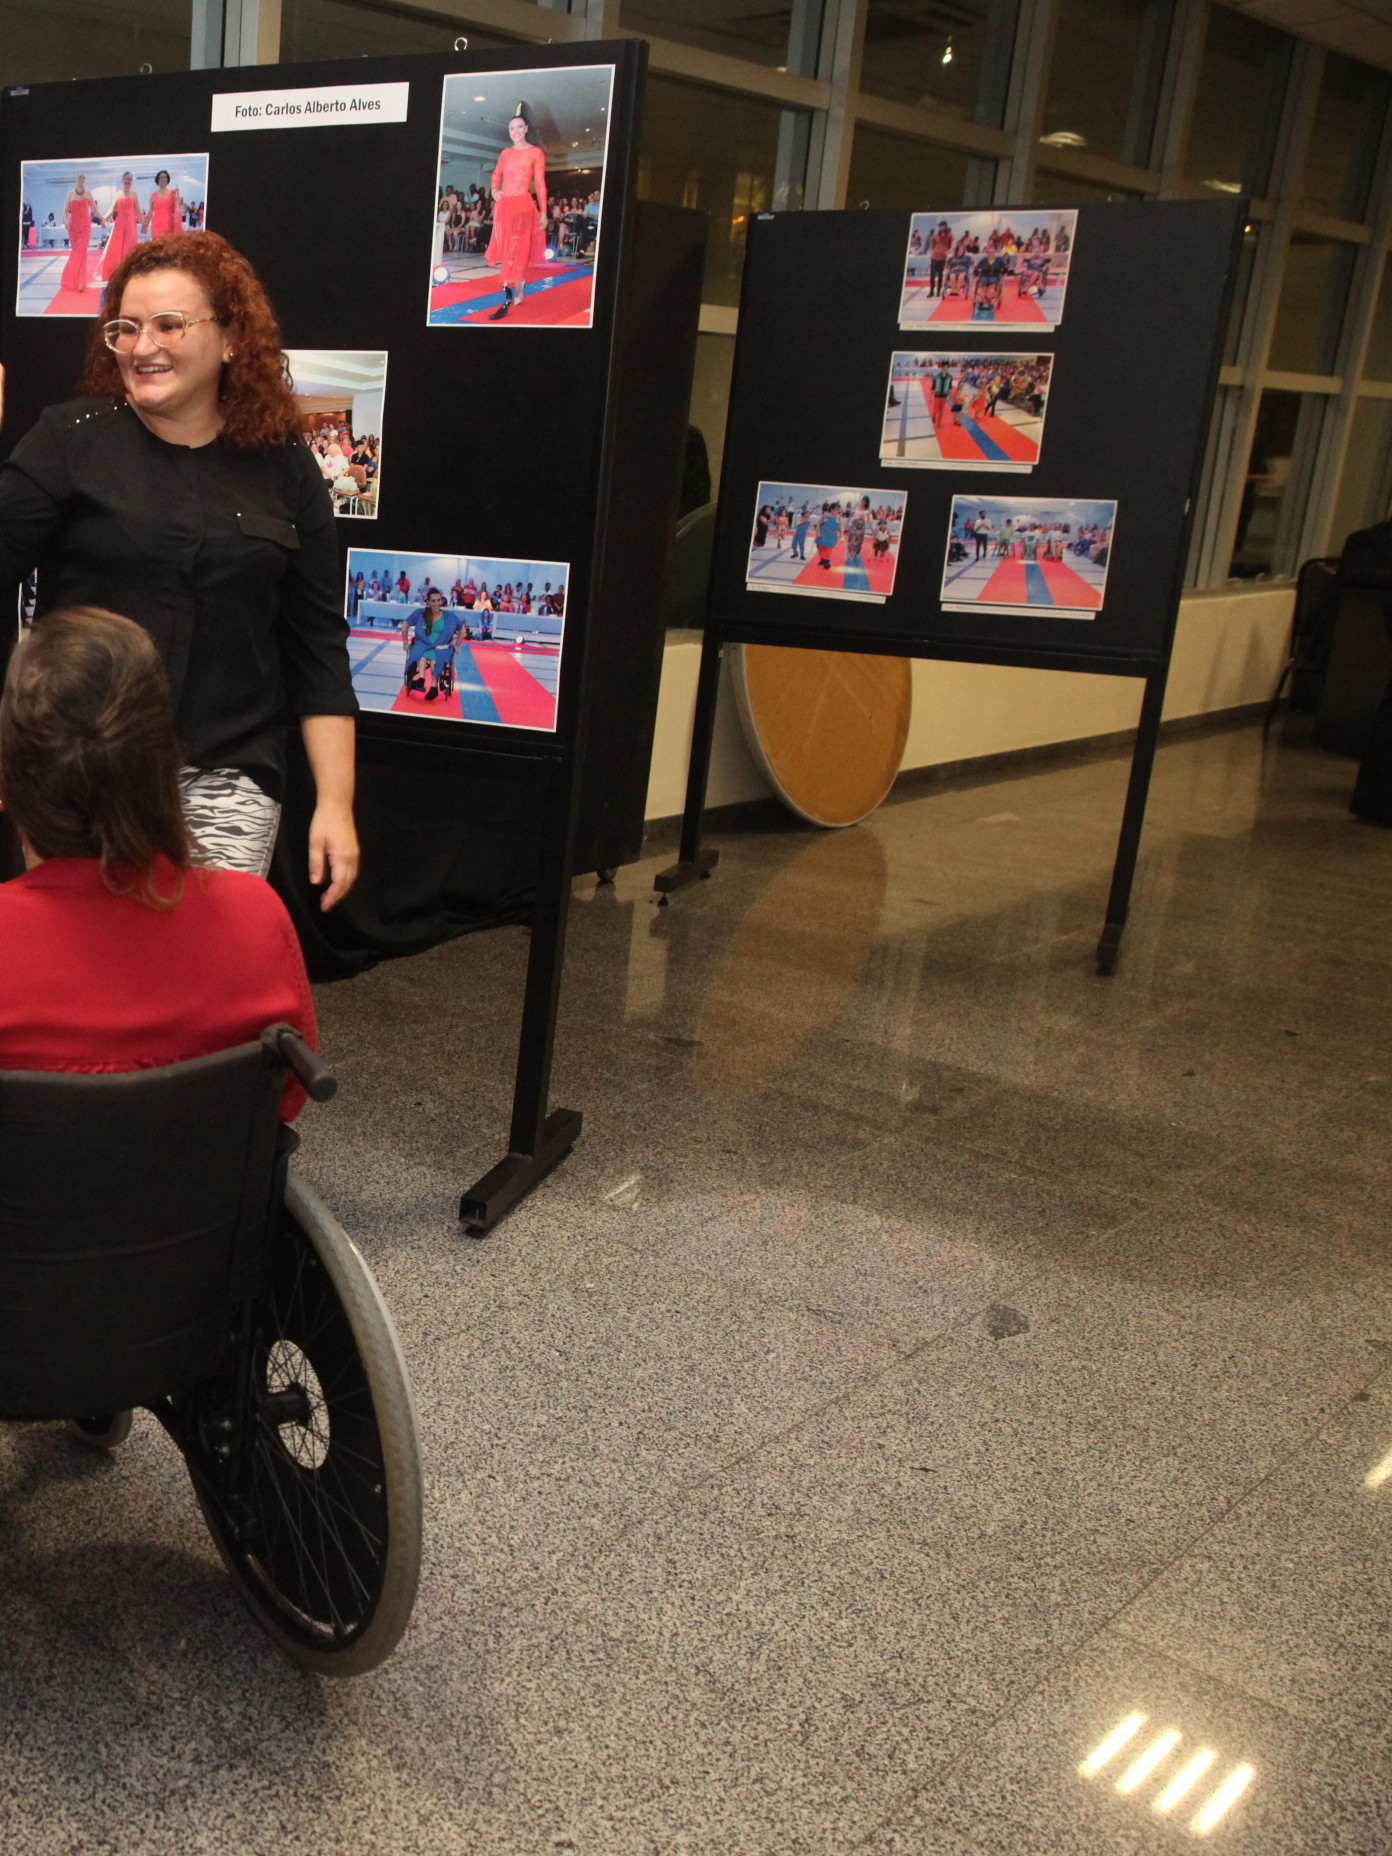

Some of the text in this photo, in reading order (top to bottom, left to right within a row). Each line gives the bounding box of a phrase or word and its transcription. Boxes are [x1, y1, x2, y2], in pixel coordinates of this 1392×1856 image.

[235, 98, 381, 118] Foto: Carlos Alberto Alves
